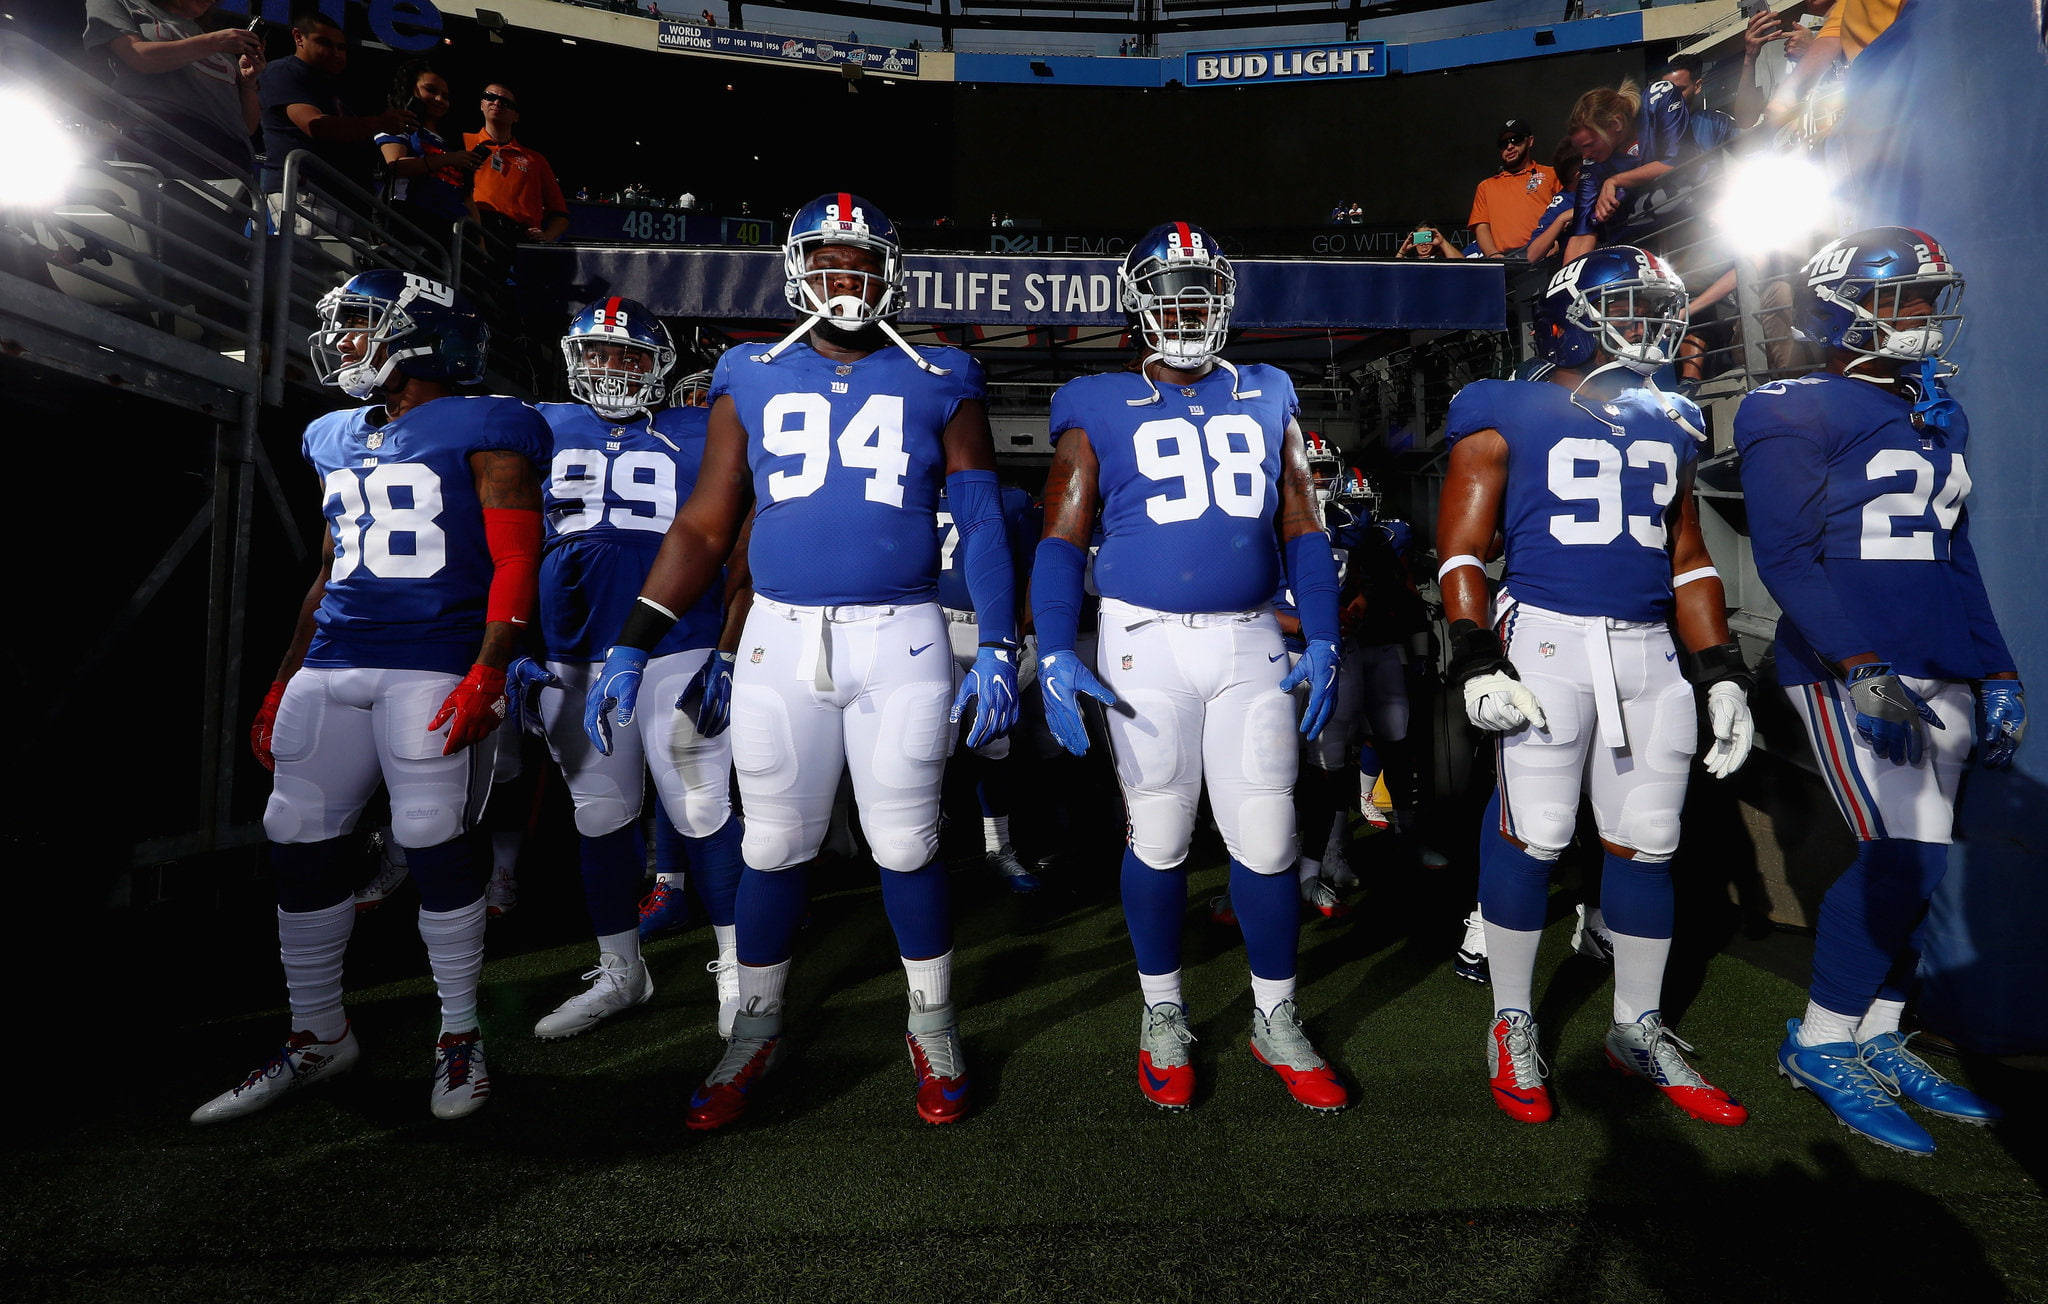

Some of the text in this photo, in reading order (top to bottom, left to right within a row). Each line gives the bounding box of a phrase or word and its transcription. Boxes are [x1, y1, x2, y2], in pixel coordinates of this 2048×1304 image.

[659, 34, 712, 48] CHAMPIONS
[669, 25, 701, 37] WORLD
[717, 36, 731, 45] 1927
[734, 38, 747, 47] 1934
[750, 40, 763, 49] 1938
[766, 42, 780, 51] 1956
[802, 46, 816, 55] 1986
[868, 53, 883, 62] 2007
[900, 57, 914, 66] 2011
[1197, 48, 1374, 81] BUD LIGHT
[825, 204, 865, 224] 94
[622, 210, 687, 242] 48:31
[736, 222, 761, 244] 40
[1064, 236, 1125, 254] EMC
[1167, 232, 1203, 249] 98
[1312, 234, 1346, 253] GO
[1024, 273, 1124, 313] STADI
[593, 309, 628, 327] 99
[762, 392, 910, 508] 94
[1306, 440, 1326, 450] 37
[1132, 414, 1266, 525] 98
[547, 448, 677, 534] 99
[1351, 479, 1369, 488] 59
[1548, 437, 1678, 550] 93
[1860, 449, 1972, 560] 24
